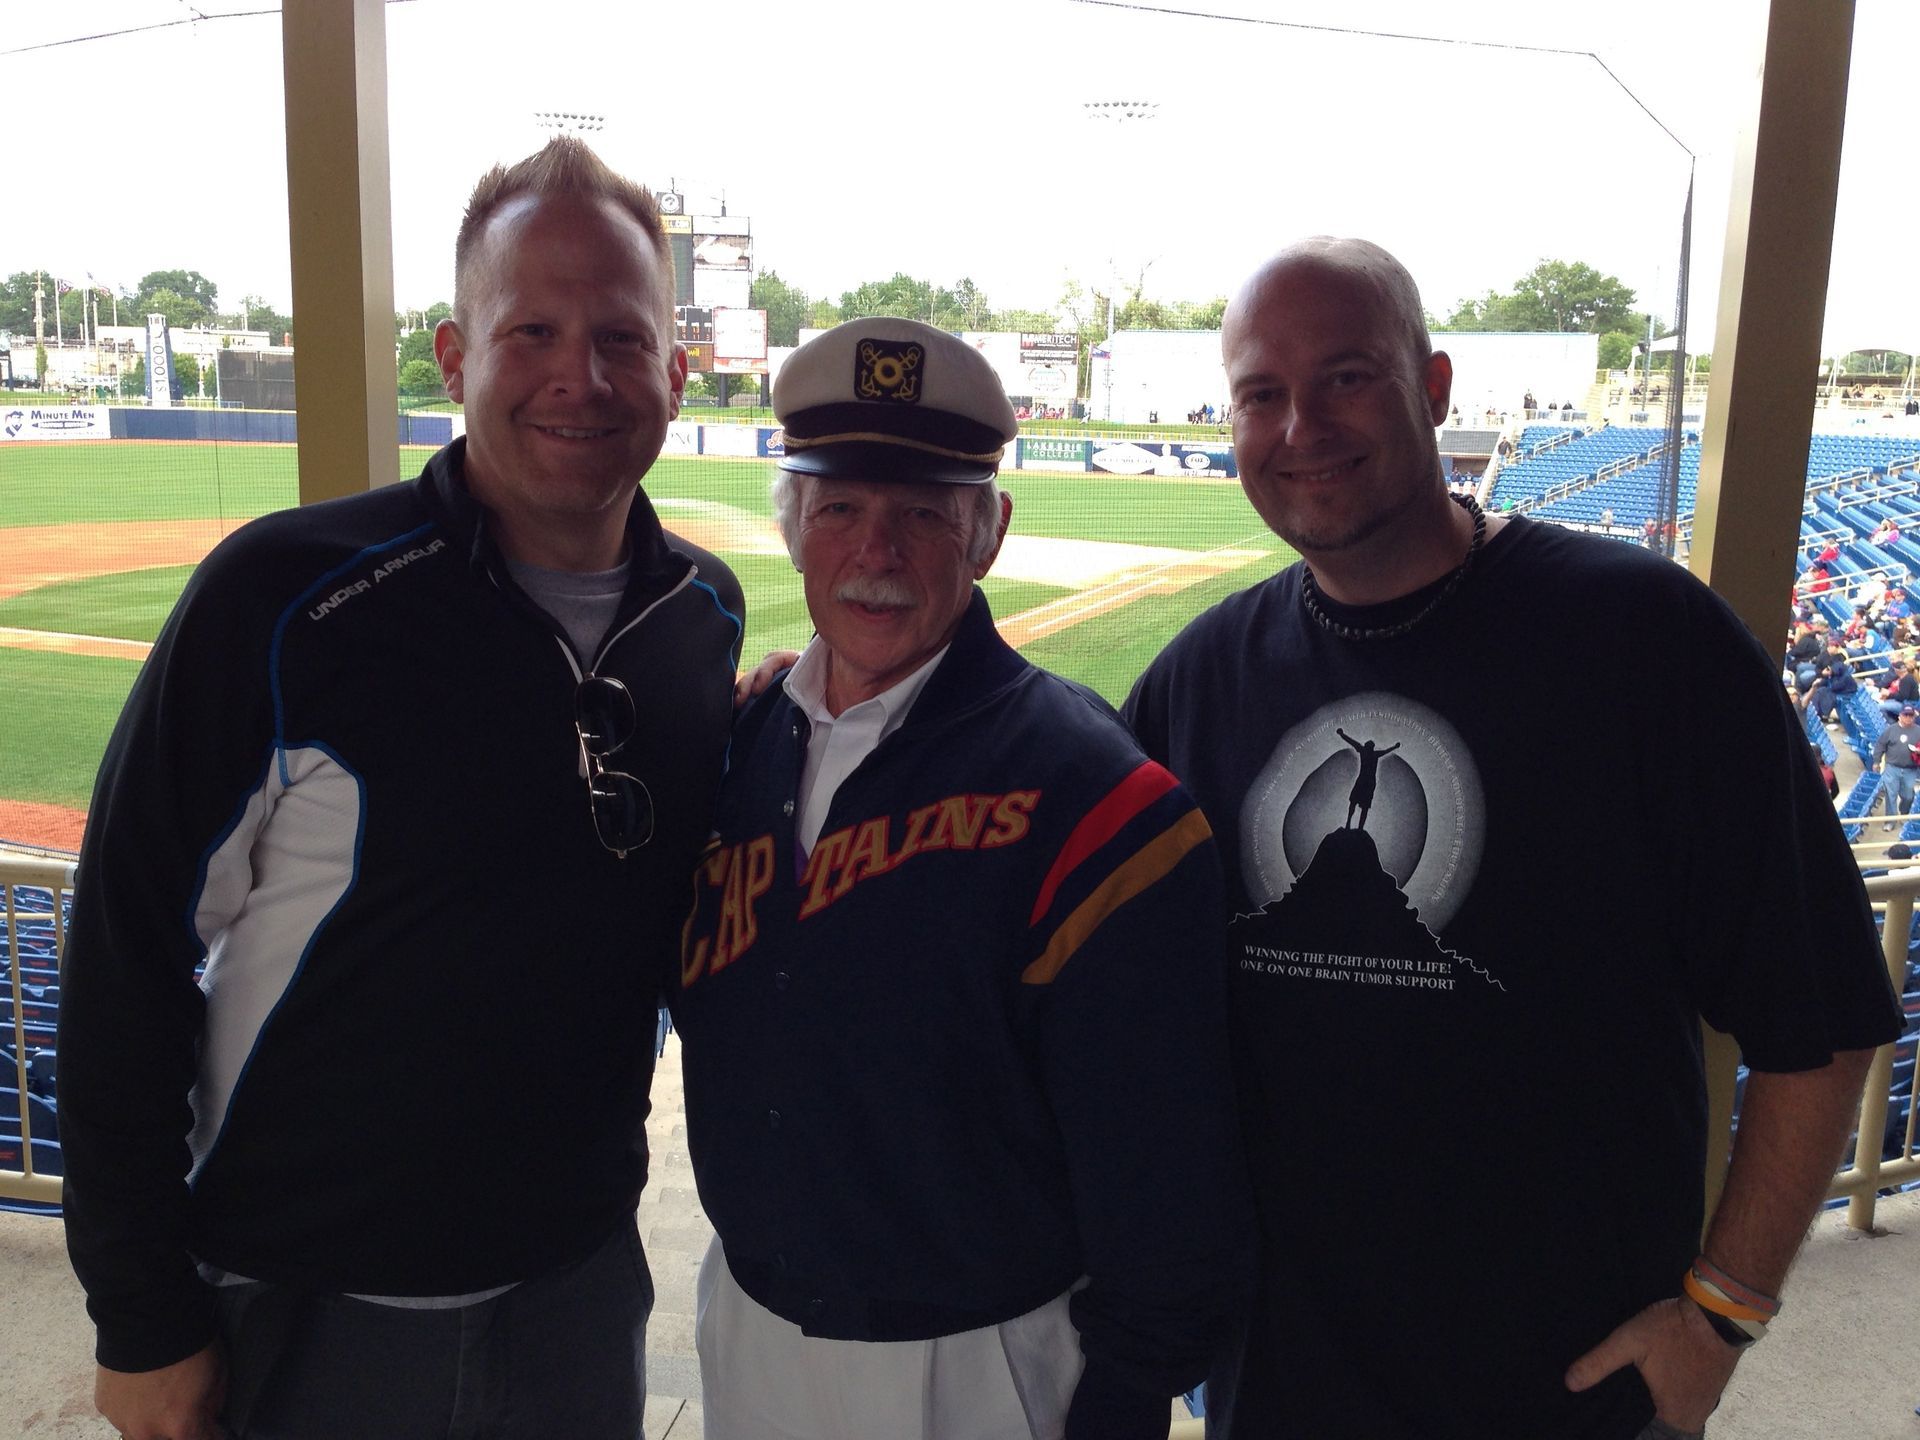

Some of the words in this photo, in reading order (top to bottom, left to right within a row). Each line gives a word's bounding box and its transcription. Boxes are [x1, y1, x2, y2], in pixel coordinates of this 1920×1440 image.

[31, 410, 69, 420] MINUTE
[72, 409, 95, 419] MEN
[1032, 449, 1076, 459] COLLEGE
[308, 579, 372, 621] UNDER
[373, 538, 446, 584] ARMOUR
[1244, 945, 1300, 962] WINNING
[1302, 952, 1325, 965] THE
[1327, 954, 1363, 968] FIGHT
[1364, 957, 1379, 969] OF
[1379, 958, 1413, 971] YOUR
[1417, 960, 1452, 974] LIFE!
[1240, 959, 1264, 972] ONE
[1267, 963, 1286, 975] ON
[1288, 965, 1313, 978] ONE
[1315, 968, 1350, 981] BRAIN
[1354, 971, 1393, 986] TUMOR
[1395, 974, 1456, 991] SUPPORT
